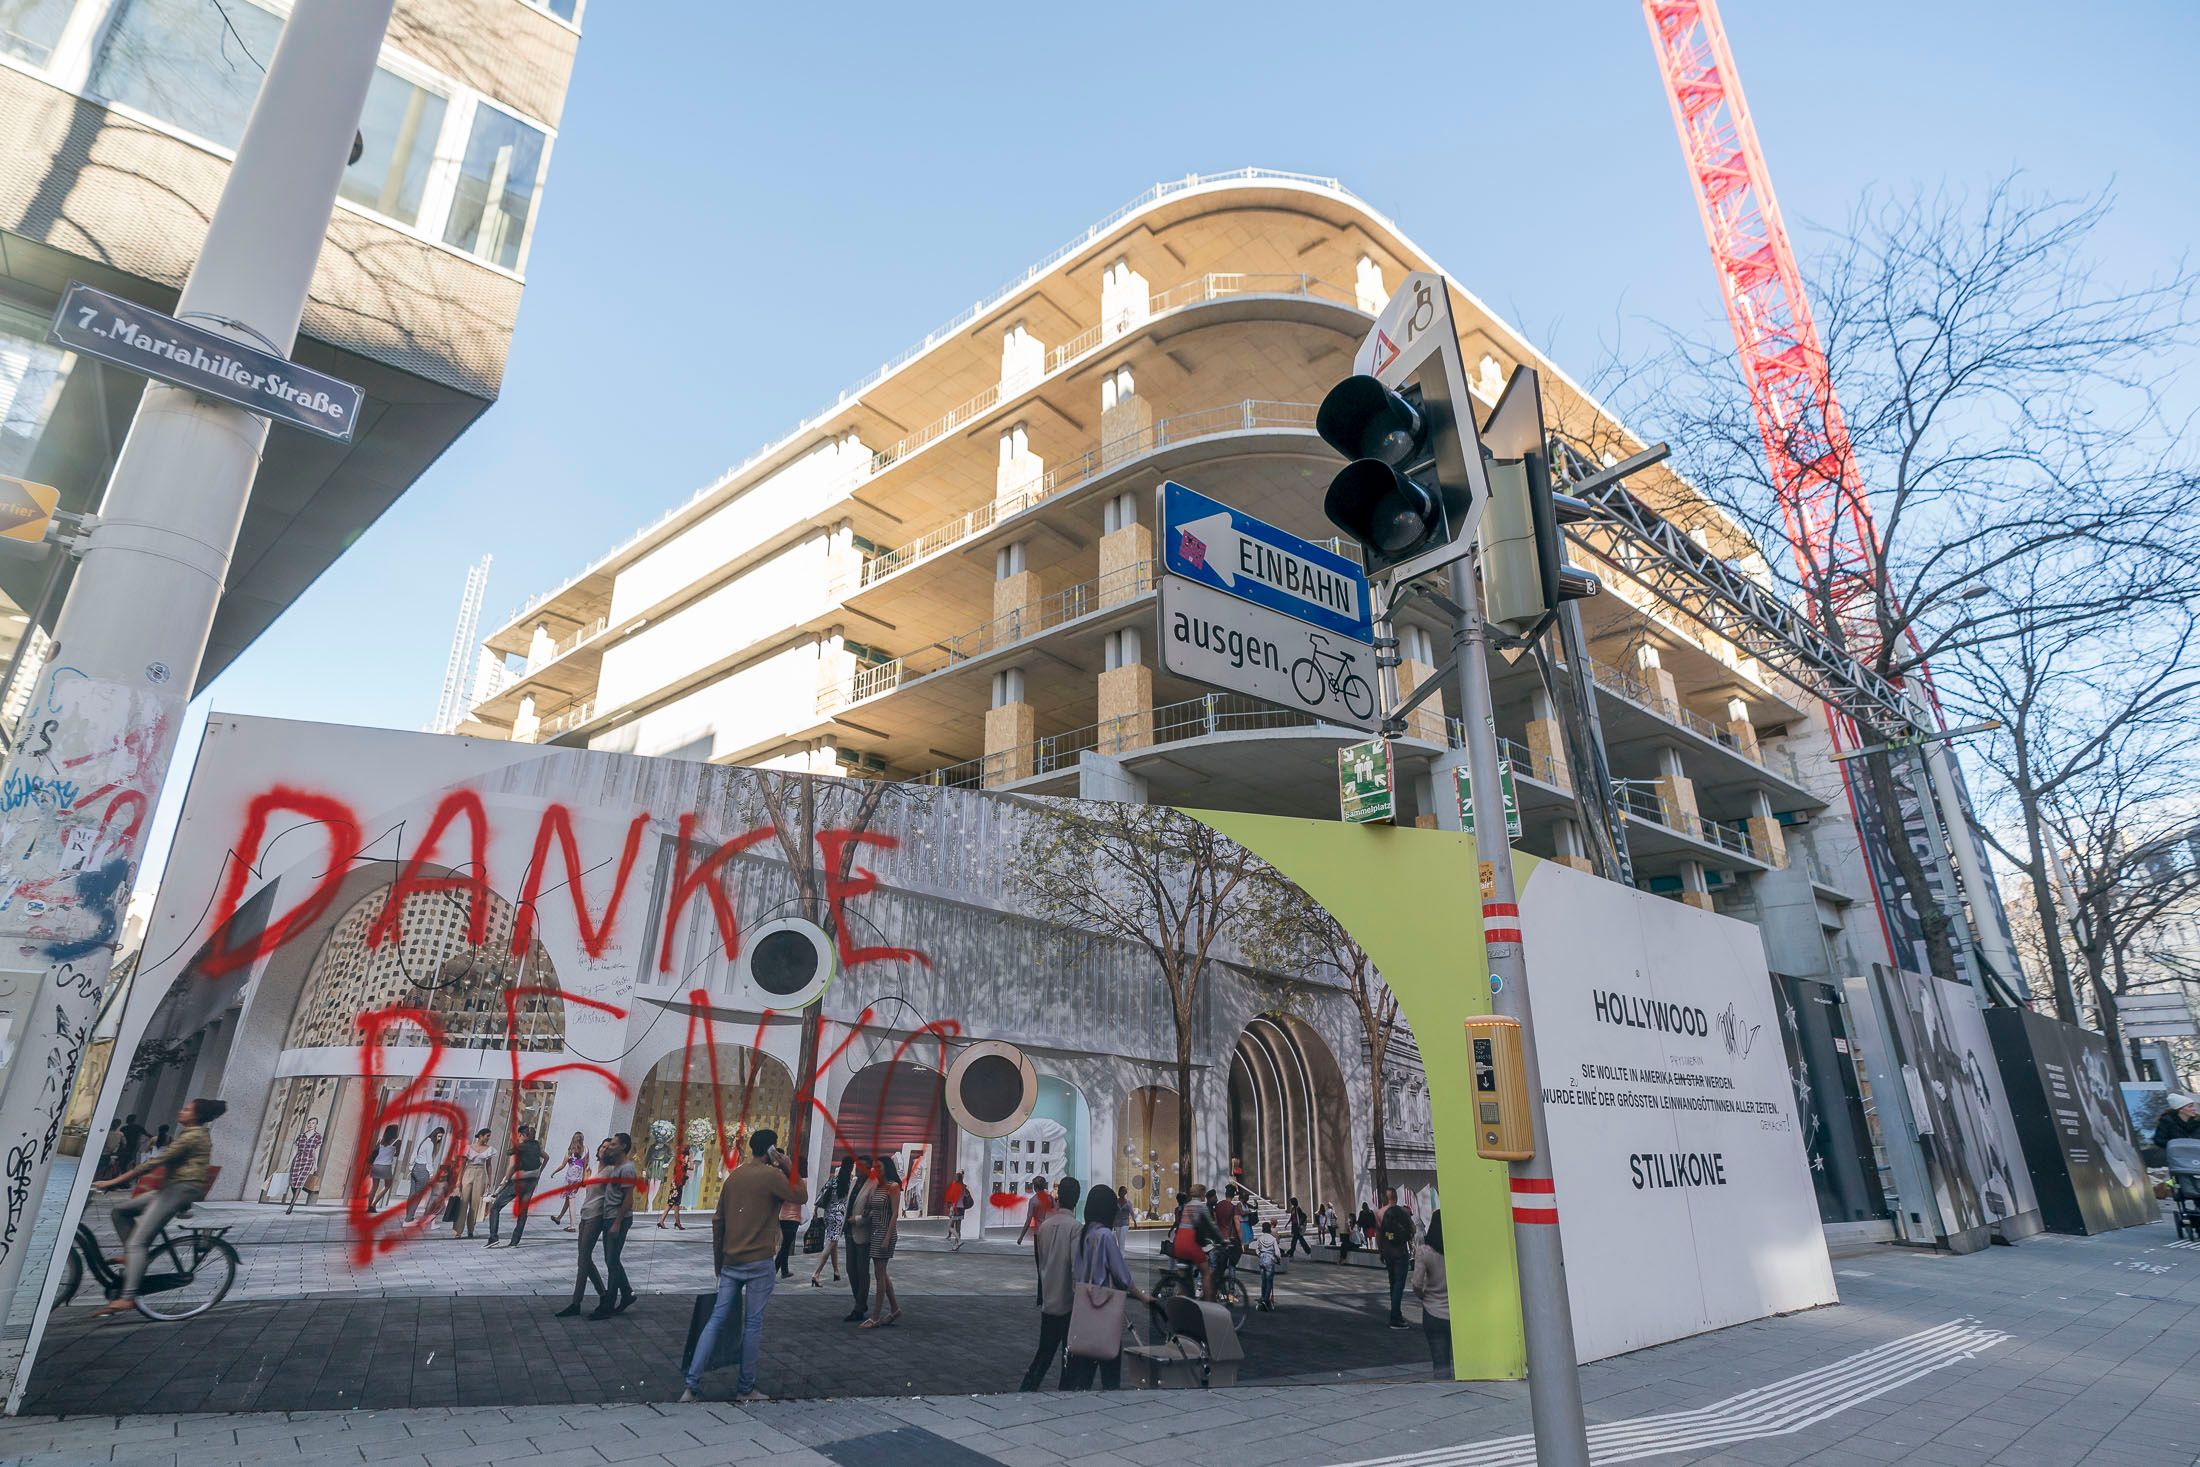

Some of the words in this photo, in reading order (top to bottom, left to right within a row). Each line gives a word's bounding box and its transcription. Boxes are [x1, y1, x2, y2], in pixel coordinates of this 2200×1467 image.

[108, 317, 266, 390] Mariahilfer
[264, 374, 344, 418] Straße
[1239, 537, 1350, 613] EINBAHN
[1587, 580, 1595, 594] 3
[1173, 611, 1288, 674] ausgen.
[1345, 802, 1392, 819] Sammelplatz
[199, 785, 932, 978] DANKE
[1593, 989, 1708, 1037] HOLLYWOOD
[1581, 1063, 1596, 1079] SIE
[1596, 1065, 1628, 1081] WOLLTE
[1629, 1068, 1638, 1082] IN
[1640, 1069, 1674, 1085] AMERIKA
[1673, 1072, 1686, 1086] EIN
[1688, 1073, 1705, 1087] STAR
[1704, 1075, 1735, 1090] WERDEN.
[1542, 1088, 1575, 1104] WURDE
[1577, 1090, 1597, 1106] EINE
[1598, 1091, 1616, 1107] DER
[1617, 1091, 1659, 1109] GRÖSSTEN
[1660, 1095, 1735, 1113] LEINWANDGÖTTINNEN
[1736, 1100, 1755, 1114] ALLER
[1755, 1102, 1779, 1114] ZEITEN.
[345, 985, 961, 1266] BENKO
[1630, 1152, 1727, 1190] STILIKONE
